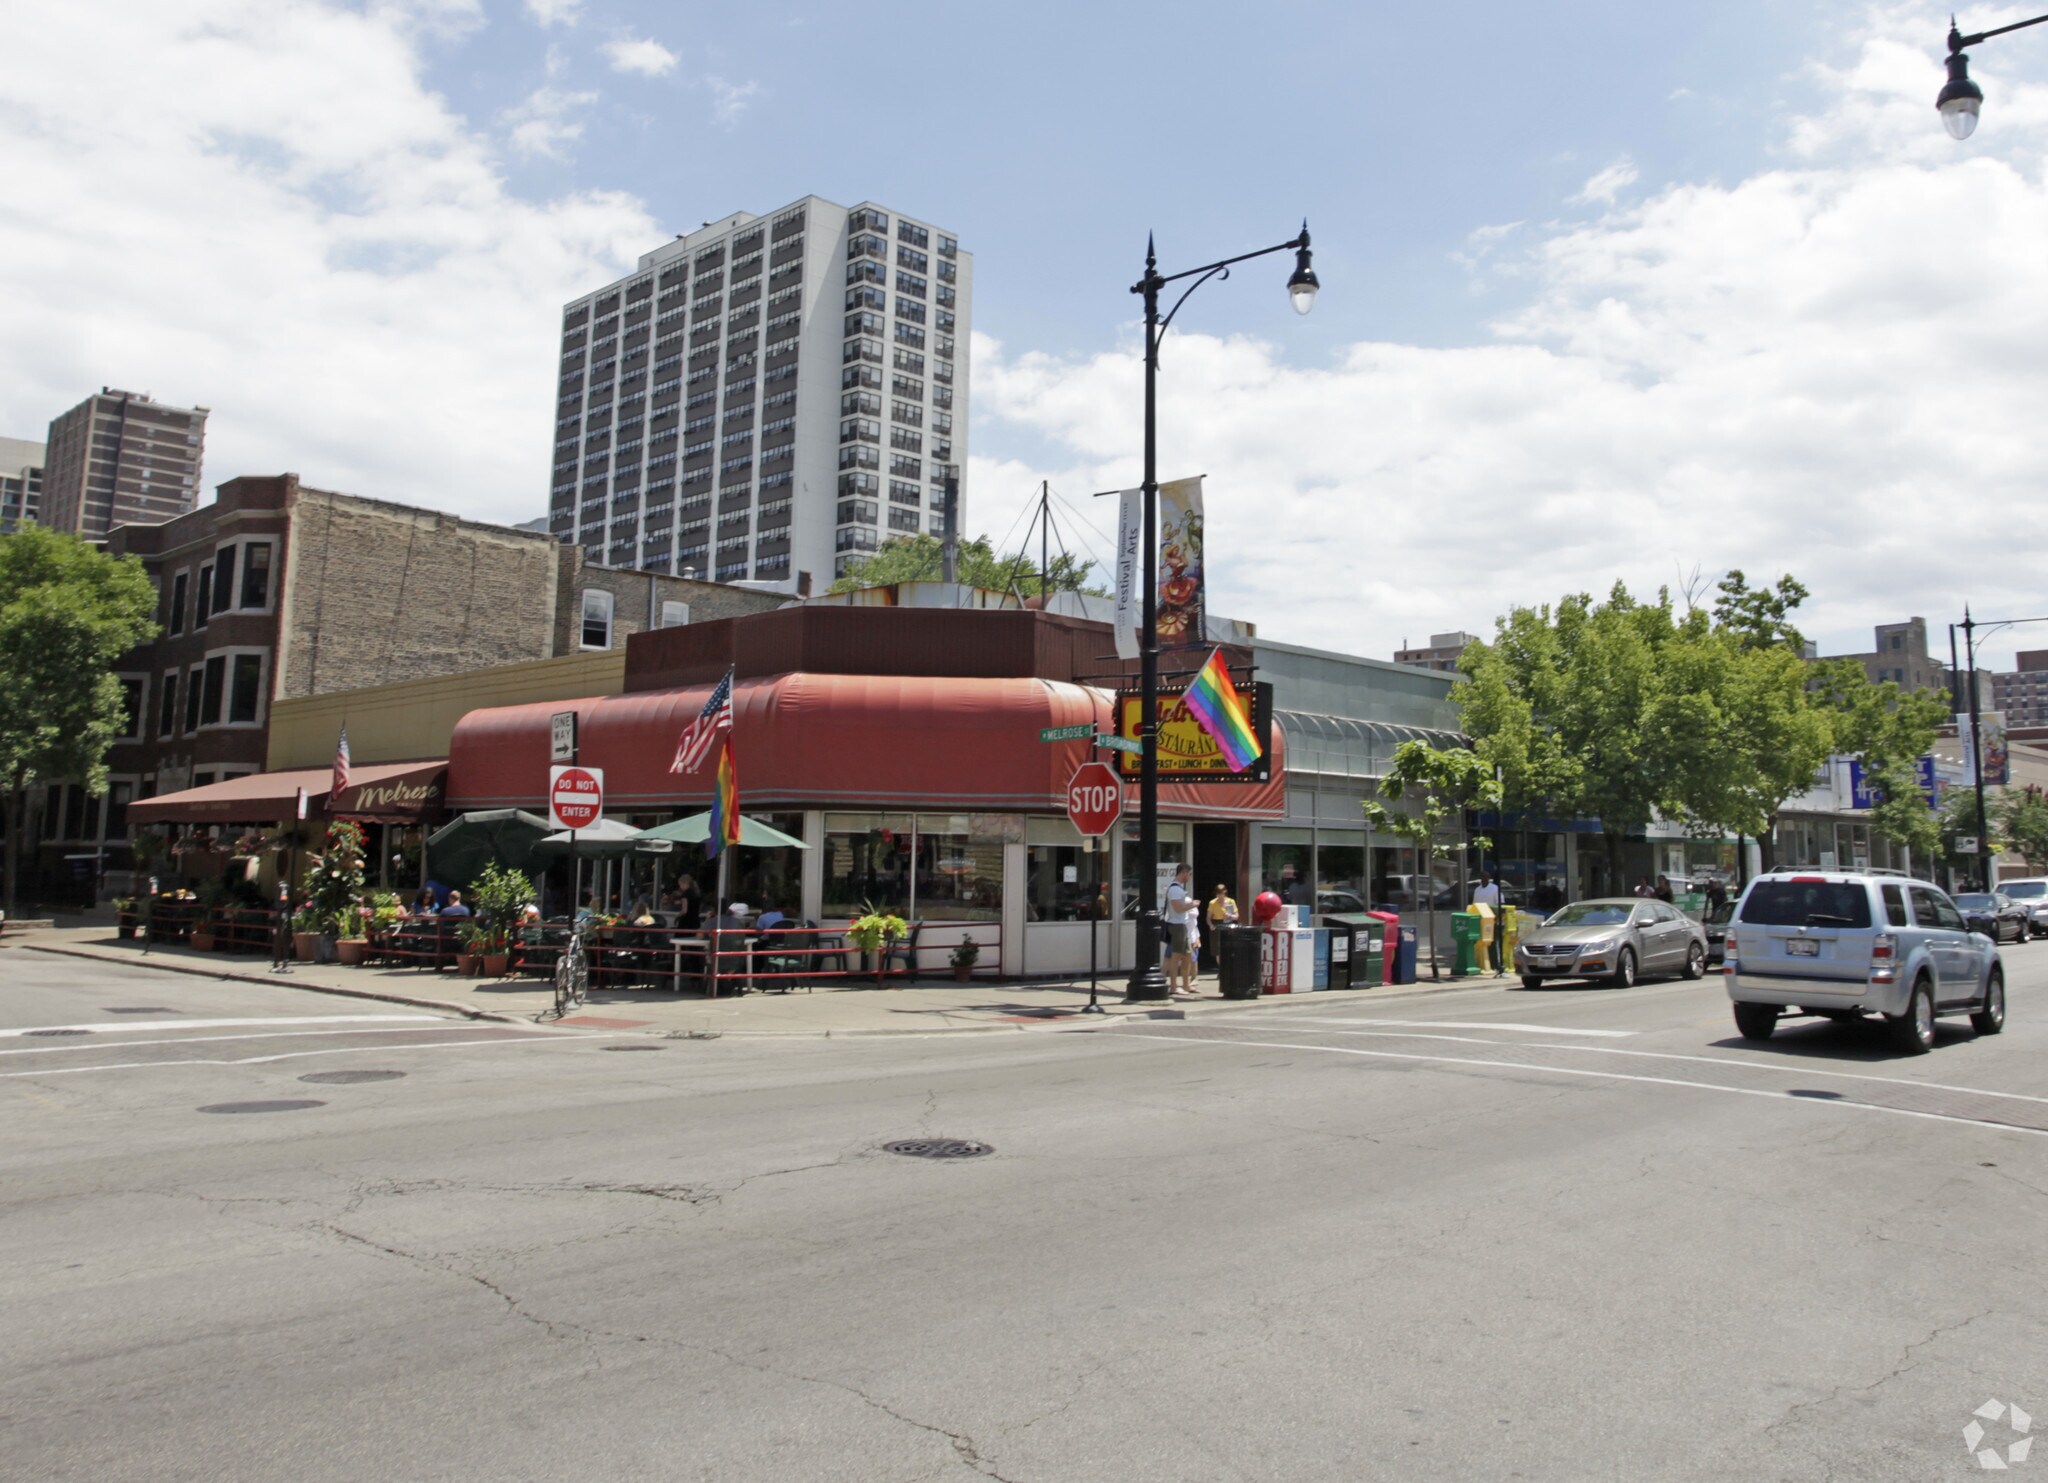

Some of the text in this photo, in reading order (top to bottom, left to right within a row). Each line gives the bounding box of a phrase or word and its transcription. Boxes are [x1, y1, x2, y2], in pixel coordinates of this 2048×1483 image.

[1127, 527, 1139, 555] Arts
[1118, 560, 1131, 611] Festival
[554, 715, 571, 729] ONE
[554, 728, 571, 741] WAY
[1046, 726, 1084, 740] MELROSE
[1178, 759, 1203, 769] LUNCH
[558, 779, 595, 790] DO NOT
[355, 780, 440, 812] Melrose
[1071, 785, 1117, 813] STOP
[562, 806, 591, 817] ENTER
